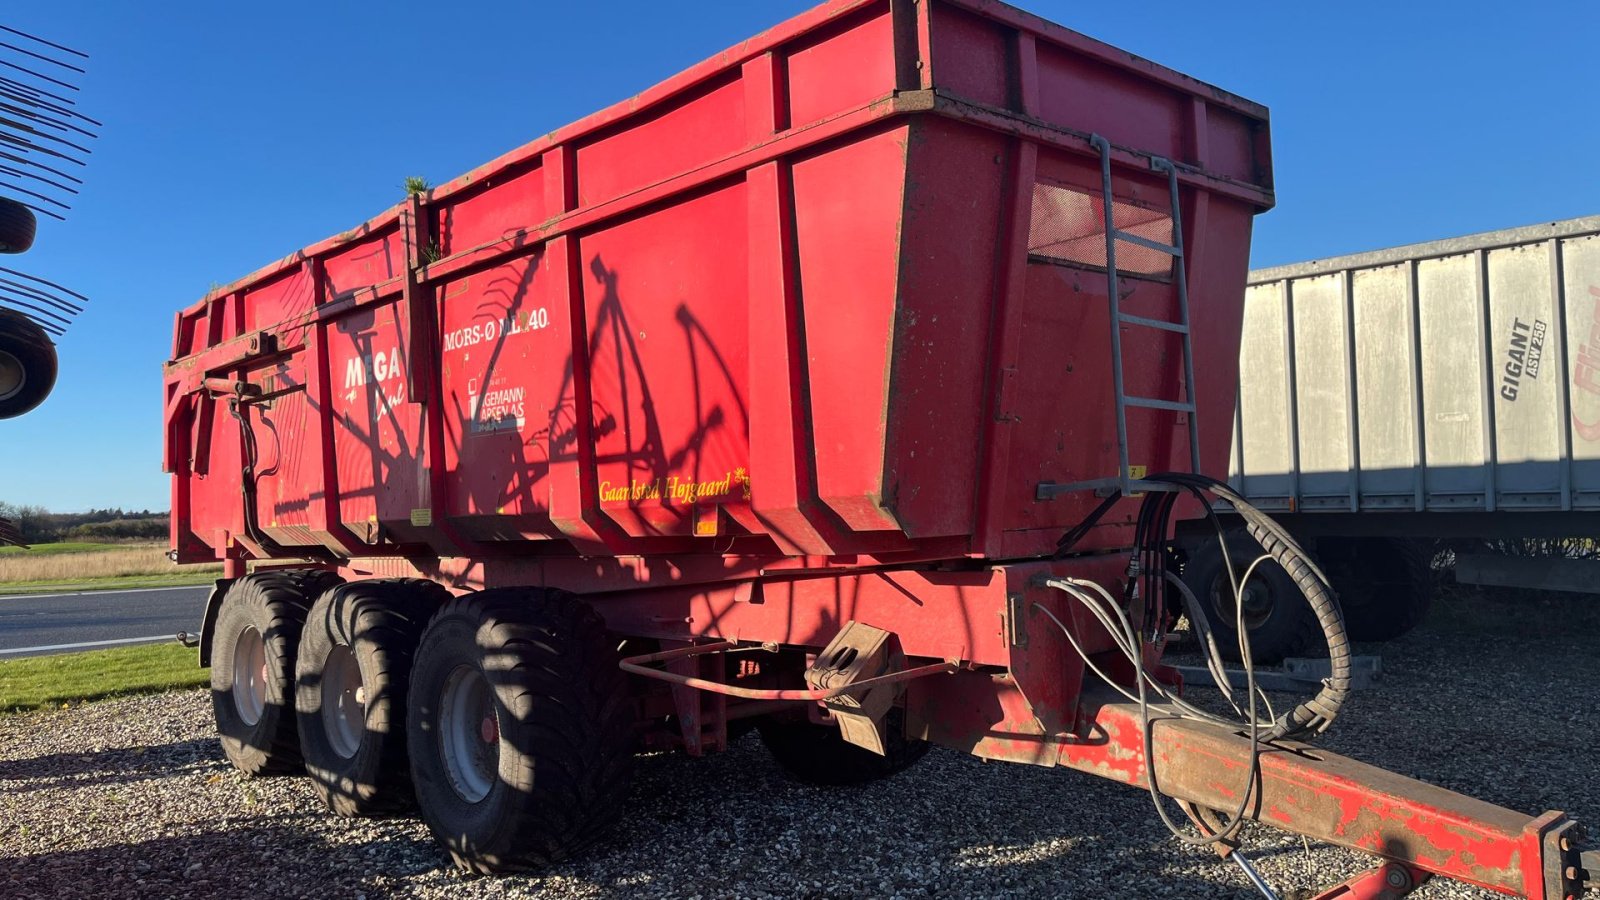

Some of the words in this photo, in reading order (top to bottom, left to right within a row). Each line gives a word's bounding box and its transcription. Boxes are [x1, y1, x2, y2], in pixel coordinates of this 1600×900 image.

[444, 321, 495, 352] MORS-Ø
[1526, 347, 1540, 378] ASW
[1533, 321, 1546, 348] 258
[345, 347, 400, 389] MEGA
[1500, 317, 1530, 402] GIGANT
[600, 478, 660, 502] Gaardsted
[663, 472, 731, 504] Højgaard
